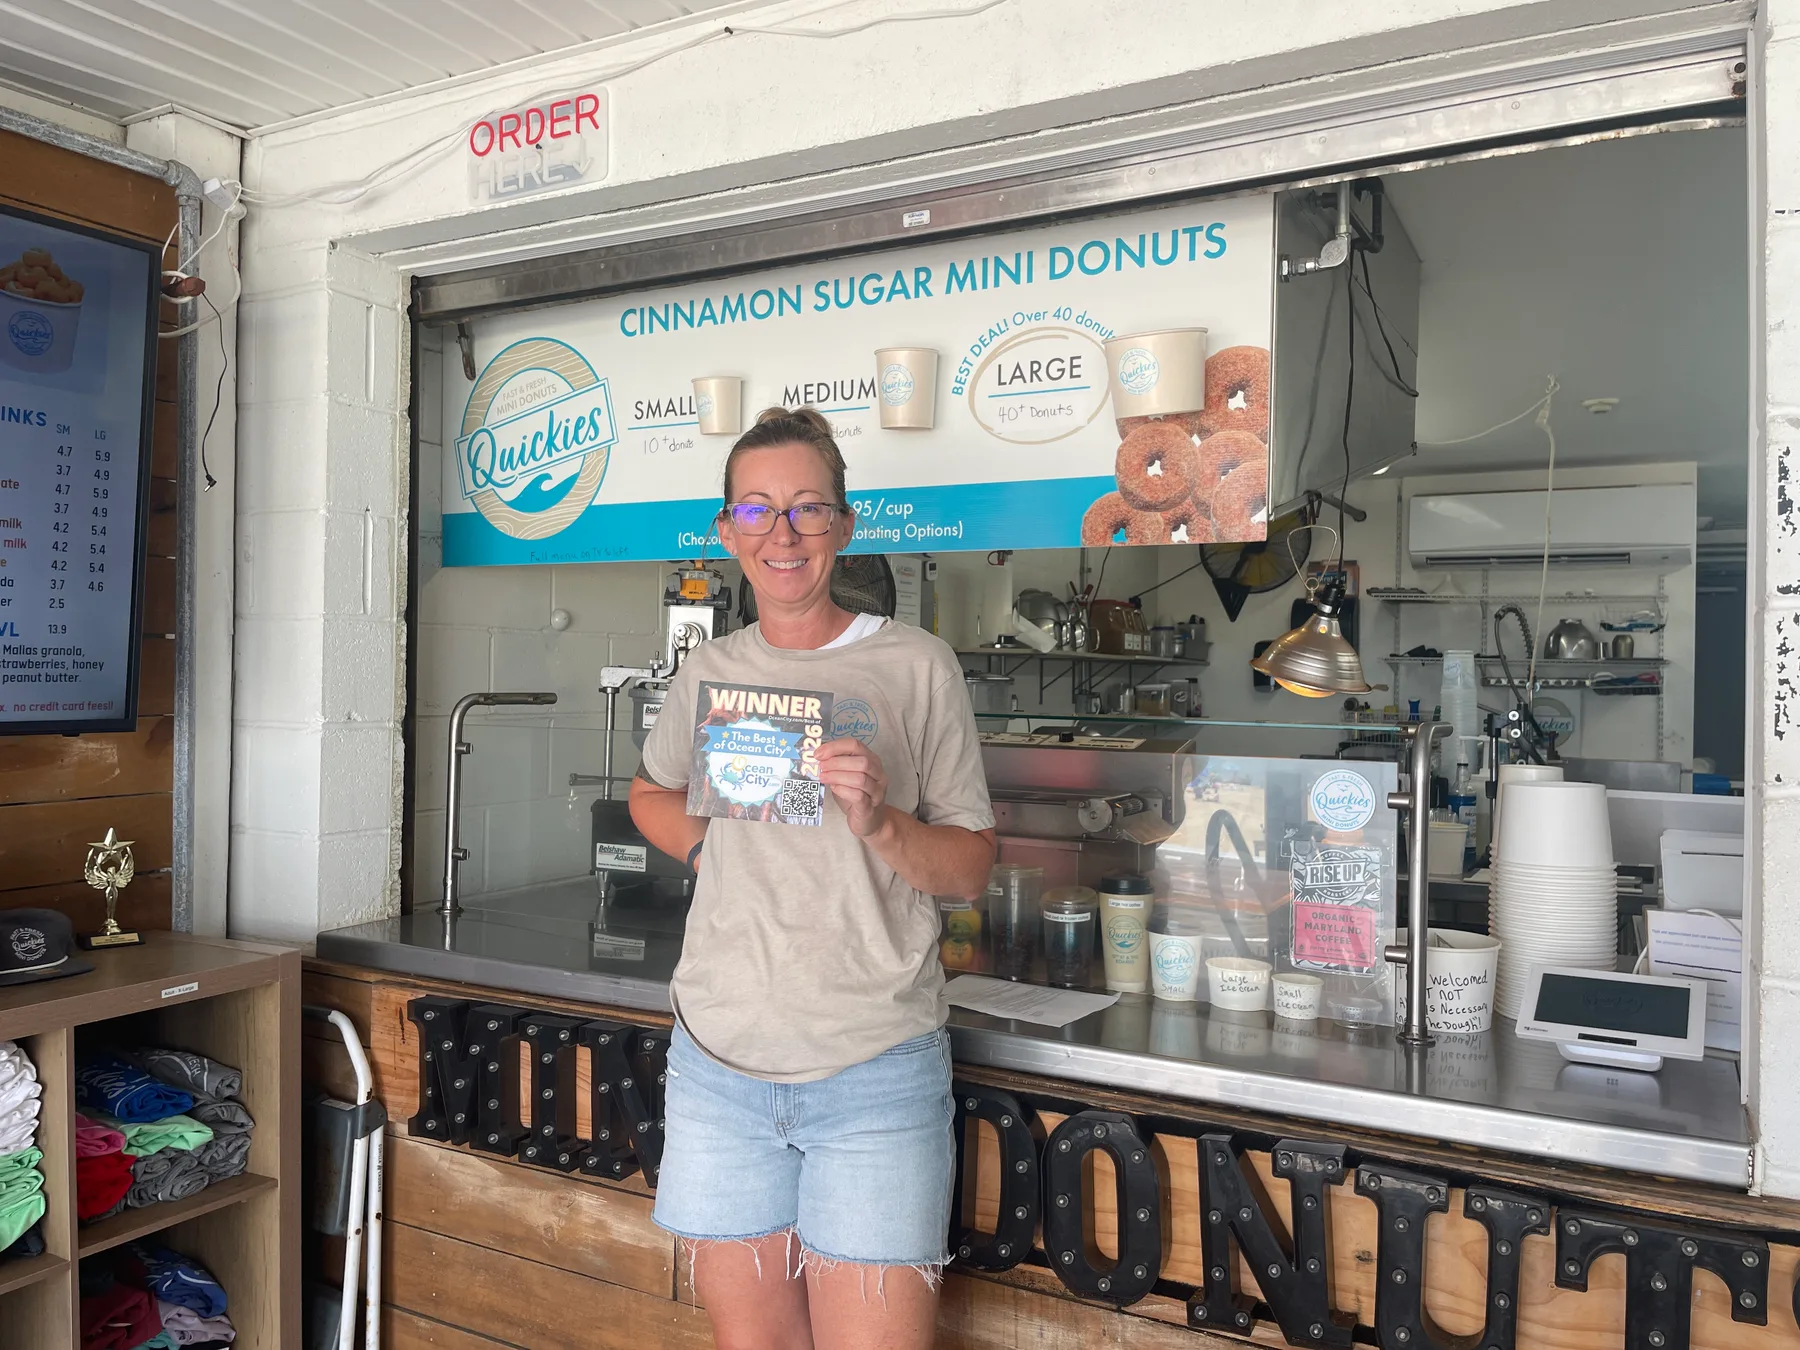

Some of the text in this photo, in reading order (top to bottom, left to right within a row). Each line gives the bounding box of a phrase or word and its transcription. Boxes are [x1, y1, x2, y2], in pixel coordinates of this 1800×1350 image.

[470, 94, 600, 157] ORDER
[472, 143, 565, 200] HERE
[620, 222, 1228, 337] CINNAMON SUGAR MINI DONUTS
[951, 357, 974, 396] BEST
[969, 318, 1010, 358] DEAL!
[1012, 310, 1049, 326] Over
[1052, 305, 1073, 322] 40
[997, 355, 1083, 386] LARGE
[502, 376, 547, 401] FAST & FRESH
[782, 377, 877, 406] MEDIUM
[496, 383, 557, 416] MINI DONUTS
[634, 395, 697, 420] SMALL
[1030, 403, 1074, 418] Donuts
[56, 423, 106, 440] SM LG
[57, 445, 111, 462] 4.7 5.9
[467, 408, 602, 489] Quickies
[56, 464, 110, 481] 3.7 4.9
[55, 483, 71, 495] 4.7
[93, 487, 109, 499] 5.9
[54, 502, 108, 518] 3.7 4.9
[0, 518, 107, 536] milk 4.2 5.4
[905, 520, 963, 542] Options)
[4, 538, 106, 555] milk 4.2 5.4
[51, 560, 105, 573] 4.2 5.4
[50, 579, 65, 590] 3.7
[88, 581, 104, 592] 4.6
[49, 598, 65, 609] 2.5
[48, 624, 67, 635] 13.9
[41, 646, 85, 658] granola,
[72, 659, 104, 671] honey
[2, 673, 42, 685] peanut
[13, 703, 26, 712] no
[29, 701, 59, 712] credit
[62, 701, 84, 711] card
[710, 687, 823, 719] WINNER
[732, 731, 776, 745] The Best
[713, 740, 726, 750] of
[727, 741, 762, 753] Ocean
[800, 724, 823, 777] 2026
[1328, 774, 1341, 782] FAST
[1348, 775, 1364, 787] FRESH
[1316, 792, 1371, 811] Quickies
[1321, 814, 1360, 828] MINI DONUTS
[599, 845, 627, 854] Belshaw
[614, 854, 645, 864] Adamatic
[1310, 864, 1362, 884] RISE UP
[1312, 911, 1355, 923] ORGANIC
[1304, 922, 1362, 935] MARYLAND
[1315, 934, 1352, 945] COFFEE
[1221, 970, 1249, 986] Large
[1429, 969, 1488, 987] Welcomed
[1161, 984, 1186, 994] SMALL
[1239, 984, 1260, 992] cream
[1278, 986, 1302, 998] Small
[1276, 999, 1316, 1010] Ice cream
[407, 994, 1800, 1350] MIN DONUT
